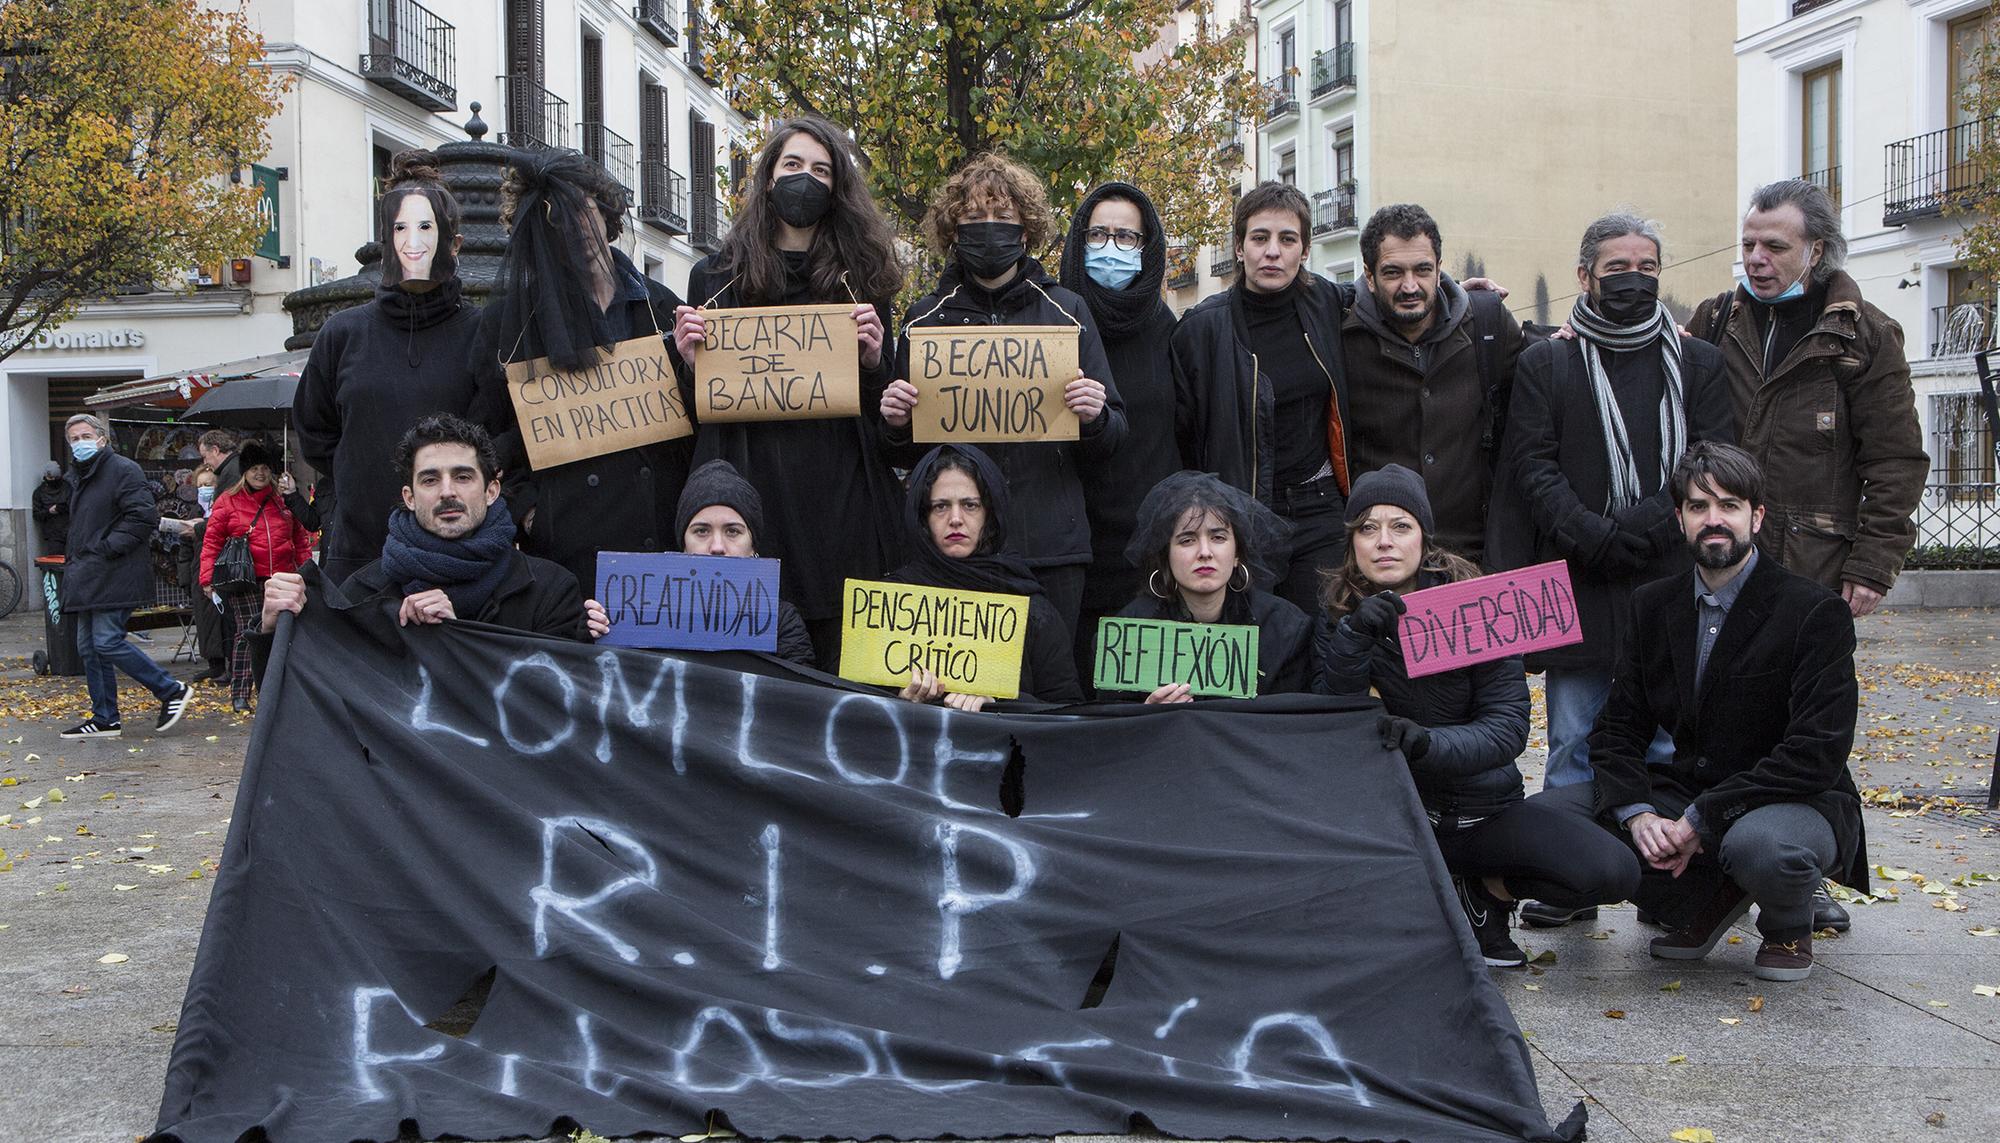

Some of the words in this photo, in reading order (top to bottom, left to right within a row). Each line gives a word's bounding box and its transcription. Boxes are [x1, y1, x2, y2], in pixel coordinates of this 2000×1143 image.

[704, 311, 833, 352] BECARIA
[520, 354, 670, 405] CONSULTORX
[738, 353, 796, 375] DE
[921, 337, 1049, 380] BECARIA
[530, 412, 565, 444] EN
[569, 385, 688, 441] PRACTICAS
[707, 370, 829, 414] BANCA
[939, 385, 1048, 435] JUNIOR
[410, 649, 1093, 819] LOMLOE
